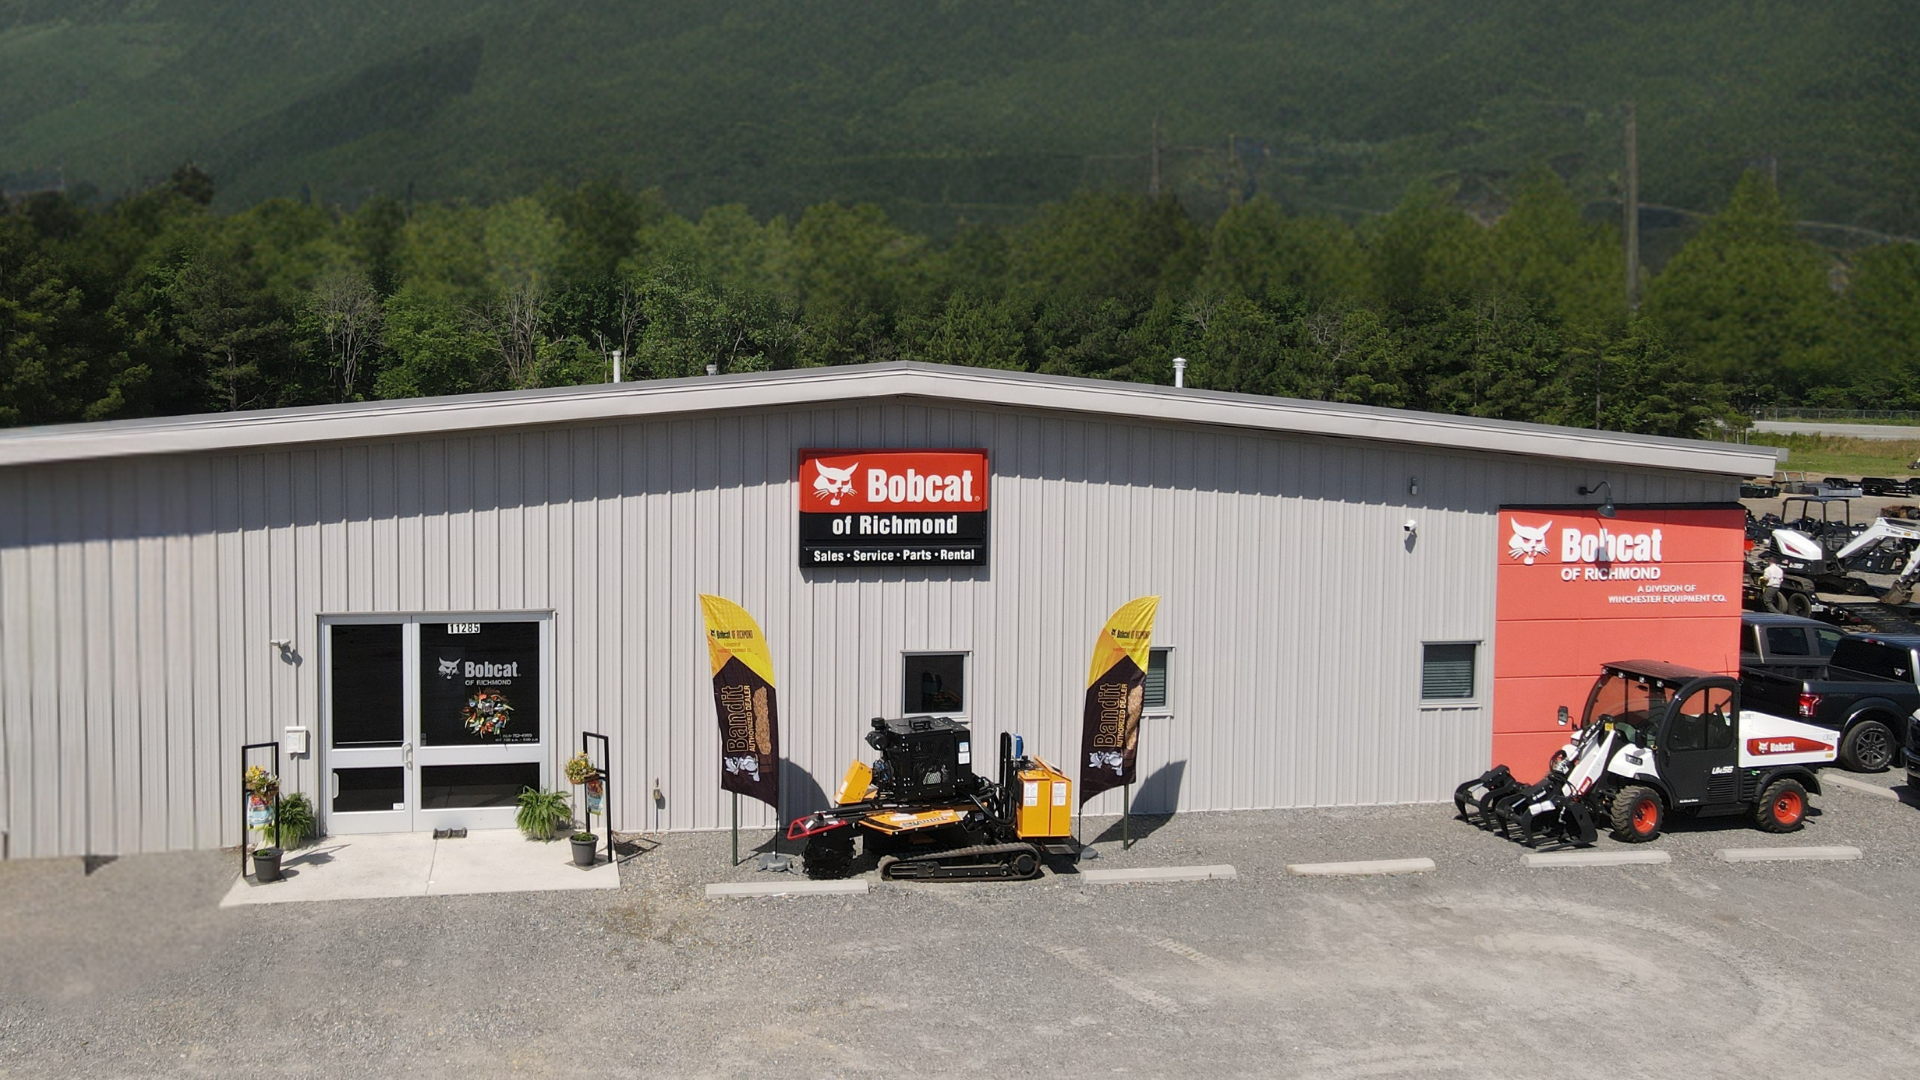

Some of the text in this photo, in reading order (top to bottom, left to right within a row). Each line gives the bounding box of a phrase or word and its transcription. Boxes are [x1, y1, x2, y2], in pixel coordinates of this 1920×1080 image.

[867, 469, 973, 503] Bobcat
[832, 514, 958, 535] of Richmond
[1561, 528, 1663, 563] Bobcat
[814, 549, 975, 562] Sales Service Parts Rental
[1561, 567, 1661, 581] OF RICHMOND
[1609, 594, 1727, 603] WINCHESTER EQUIPMENT CO.
[1646, 585, 1683, 593] DIVISION
[449, 623, 480, 634] 11285
[464, 661, 519, 678] Bobcat
[721, 685, 749, 753] Bandit
[744, 685, 756, 752] AUTHORIZED DEALER
[1093, 683, 1121, 747] Bandit
[1117, 683, 1128, 748] AUTHORIZED DEALER
[1769, 741, 1795, 753] Bobcat
